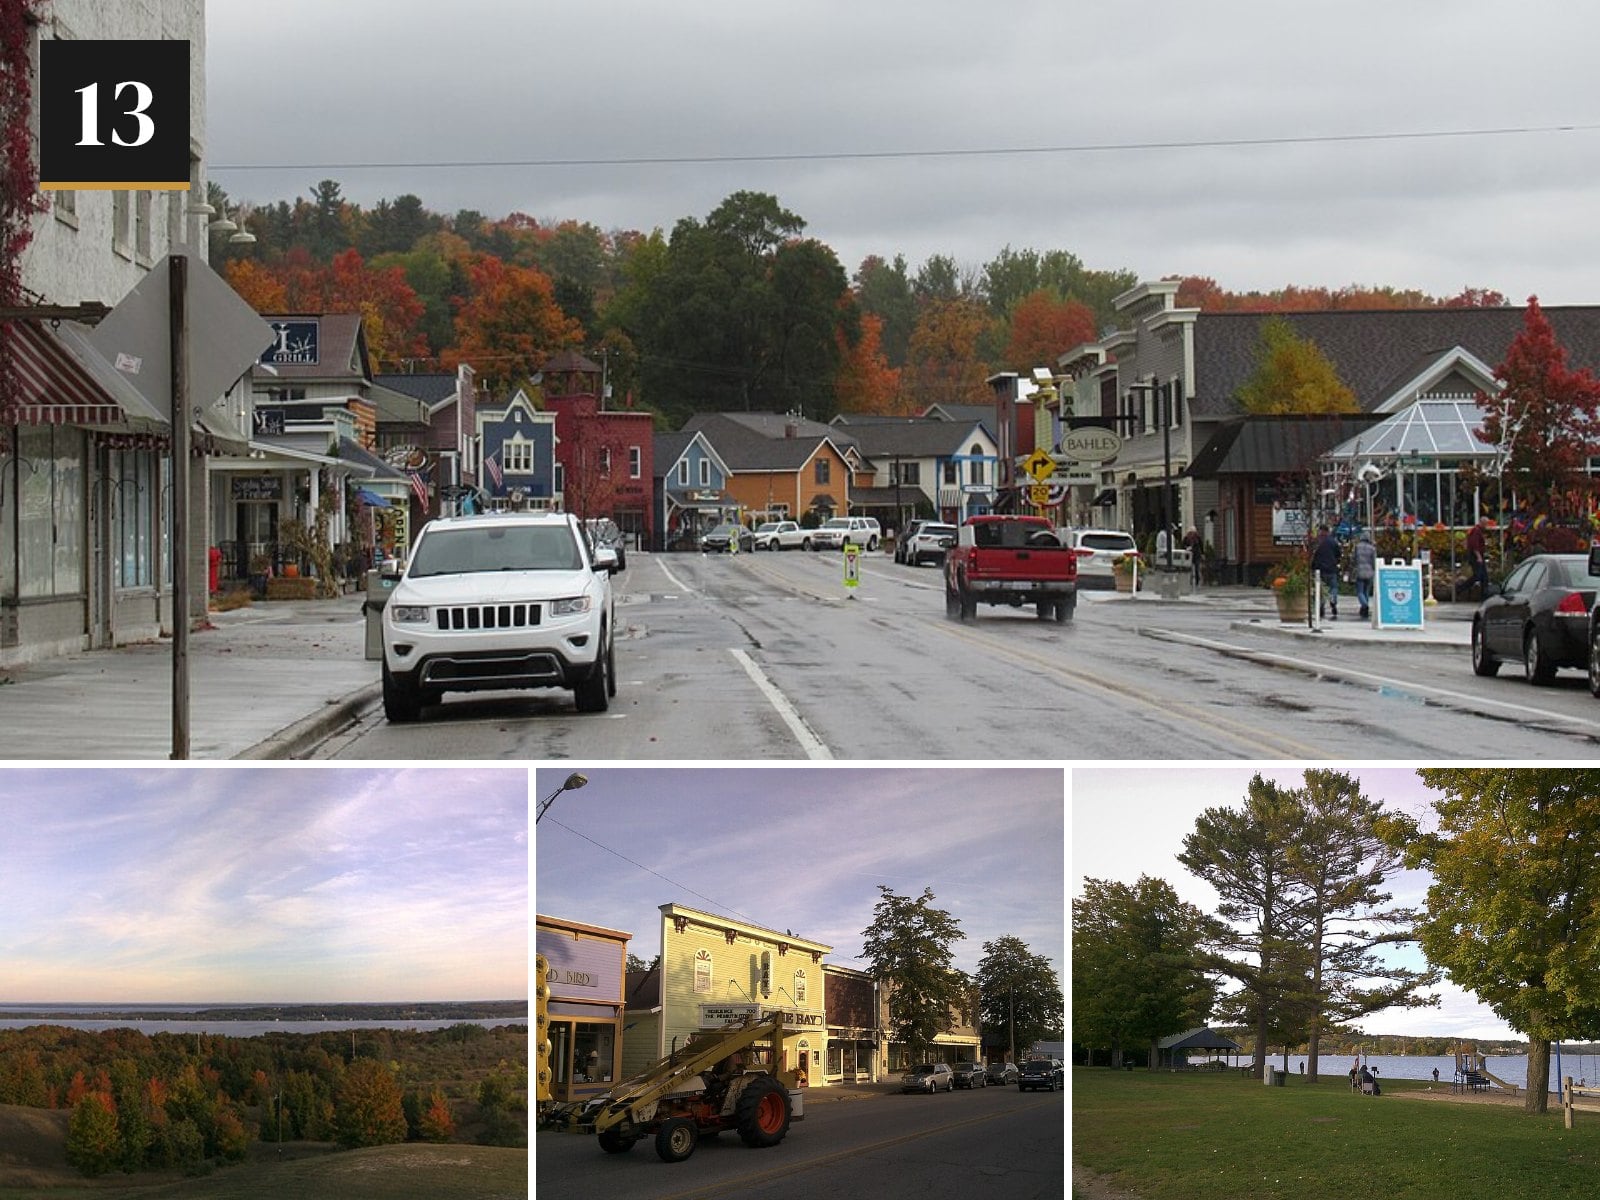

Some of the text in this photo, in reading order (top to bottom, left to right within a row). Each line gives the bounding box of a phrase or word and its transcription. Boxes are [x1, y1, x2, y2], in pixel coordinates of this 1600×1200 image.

[1033, 487, 1048, 496] 20
[566, 970, 590, 985] BIRD
[795, 1013, 817, 1026] BAY
